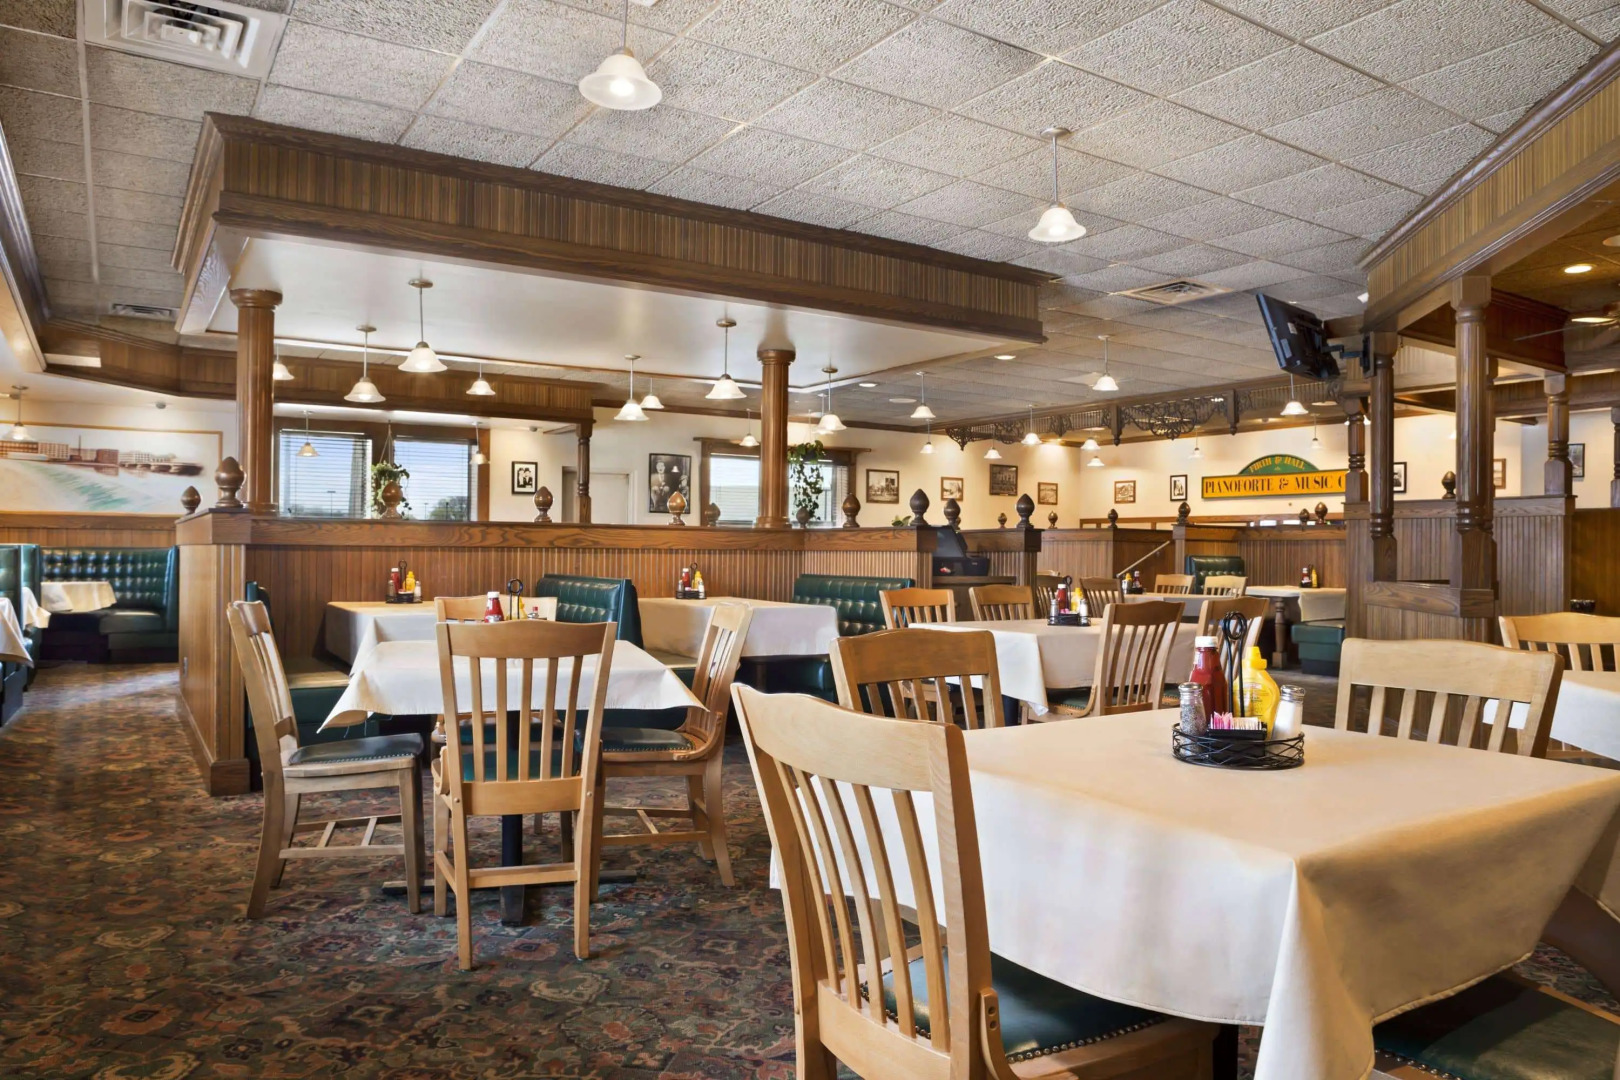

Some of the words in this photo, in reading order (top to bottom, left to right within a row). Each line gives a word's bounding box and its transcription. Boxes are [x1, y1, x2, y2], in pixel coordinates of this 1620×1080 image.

[1284, 456, 1305, 470] HALL
[1205, 478, 1274, 494] PIANOFORTE
[1279, 477, 1289, 490] &
[1295, 475, 1333, 490] MUSIC
